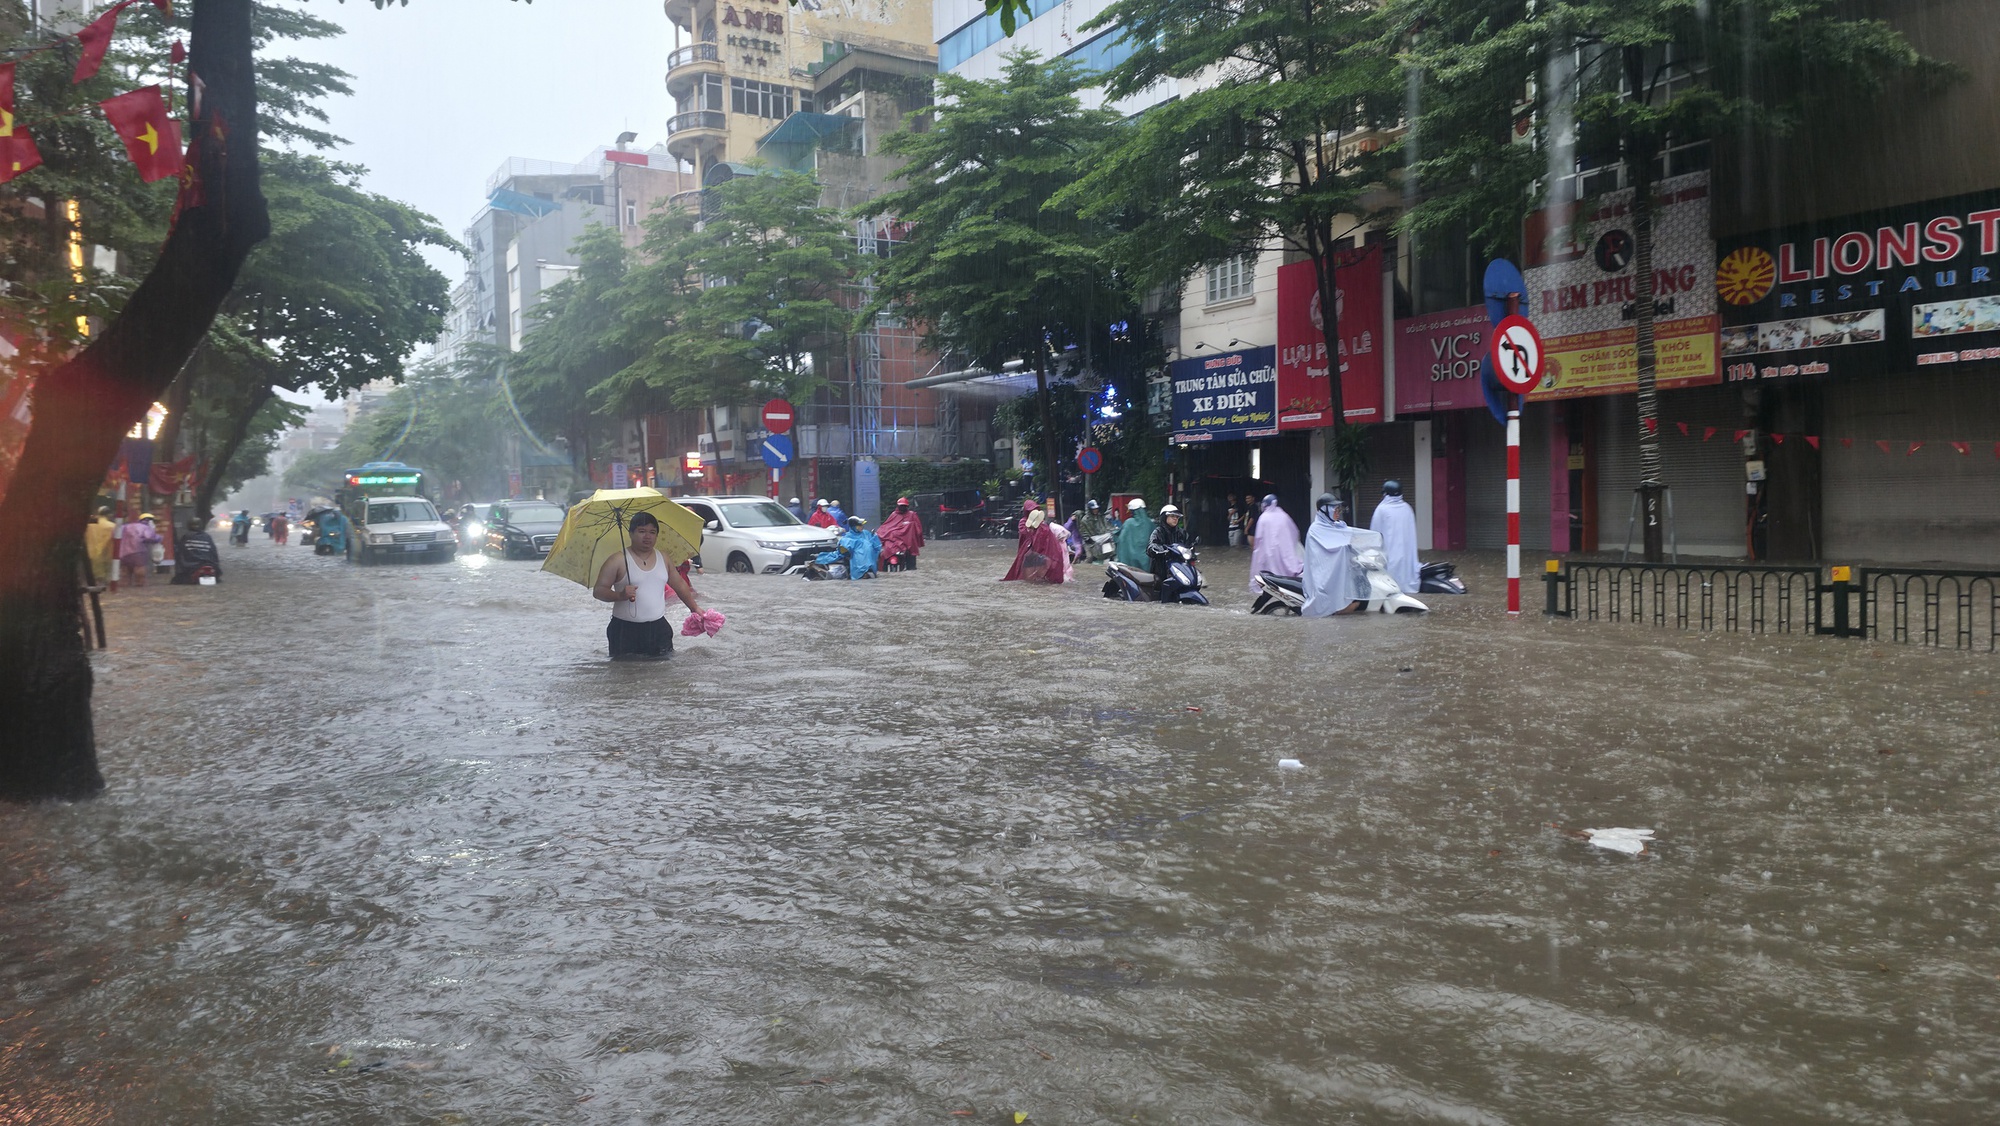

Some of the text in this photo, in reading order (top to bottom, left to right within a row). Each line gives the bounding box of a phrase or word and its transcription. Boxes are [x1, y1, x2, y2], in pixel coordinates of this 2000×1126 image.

[722, 6, 784, 34] ANH
[727, 34, 781, 53] HOTEL
[1779, 208, 2000, 284] LIONST
[1315, 338, 1348, 360] PA
[1352, 330, 1372, 354] LÊ
[1175, 365, 1277, 393] TRUNG TÂM SỬA CHỮA
[1431, 360, 1480, 382] SHOP
[1727, 362, 1756, 381] 114
[1192, 388, 1257, 412] XE ĐIỆN
